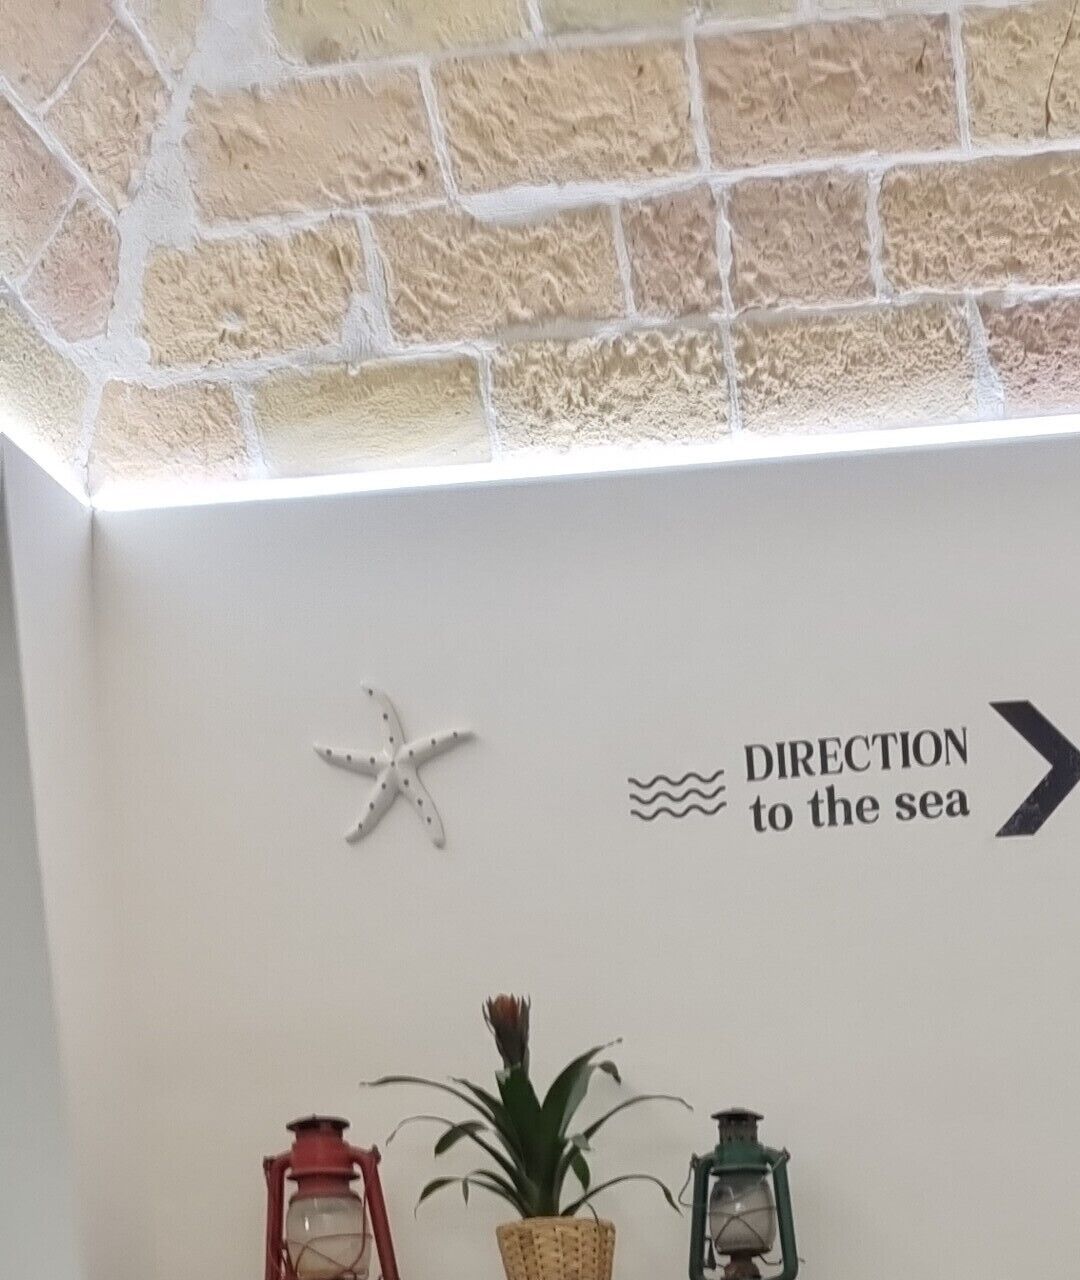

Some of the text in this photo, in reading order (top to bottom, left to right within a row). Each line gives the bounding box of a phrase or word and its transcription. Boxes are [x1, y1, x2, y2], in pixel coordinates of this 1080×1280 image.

[744, 726, 969, 782] DIRECTION
[749, 784, 970, 833] to the sea
